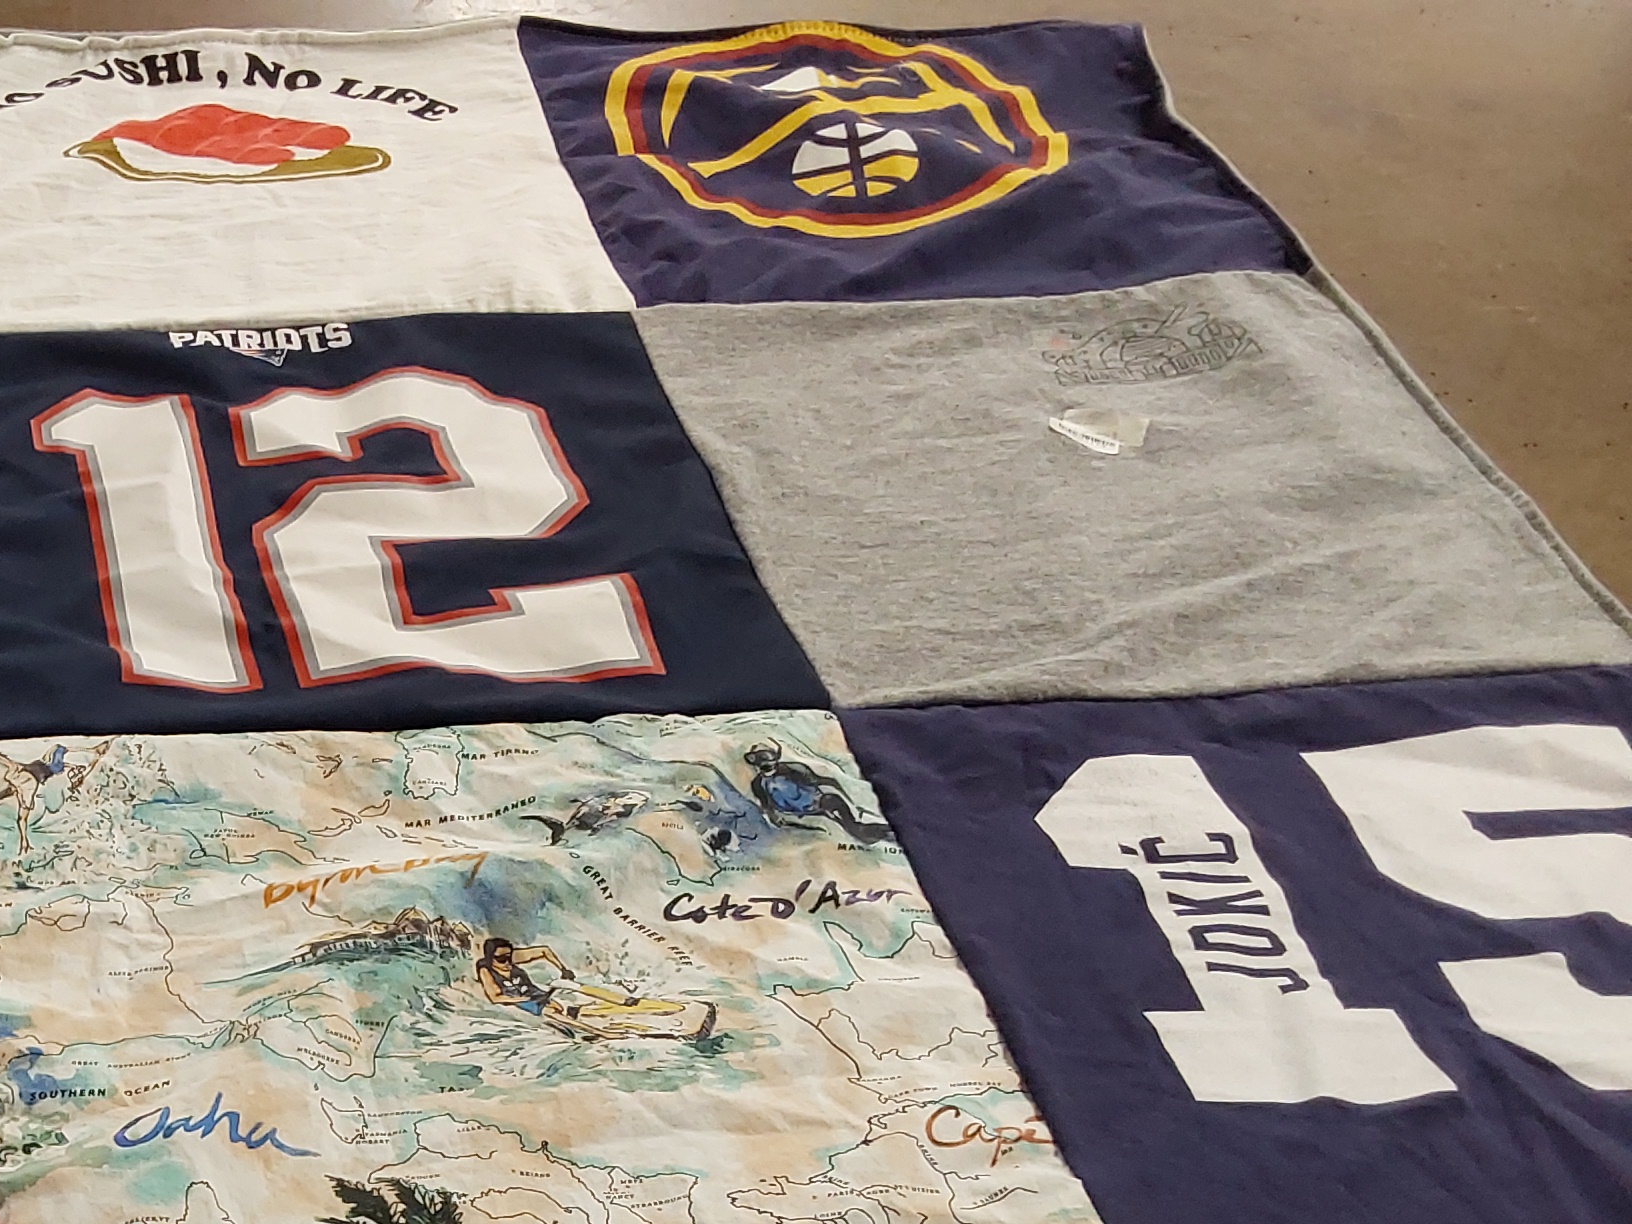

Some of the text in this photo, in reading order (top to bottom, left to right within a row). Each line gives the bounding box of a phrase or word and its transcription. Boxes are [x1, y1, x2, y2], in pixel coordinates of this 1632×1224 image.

[244, 51, 323, 91] NO
[331, 78, 459, 122] LIFE
[168, 322, 353, 353] PATRIOTS
[30, 365, 667, 694] 12
[461, 752, 486, 761] MAR
[404, 794, 537, 829] MAR MEDITERRANEO
[582, 865, 614, 901] GREAT
[613, 906, 666, 943] BARRIER
[663, 892, 765, 925] Cote
[29, 1080, 172, 1101] SOUTHERN OCEAN
[113, 1091, 322, 1158] Oahu
